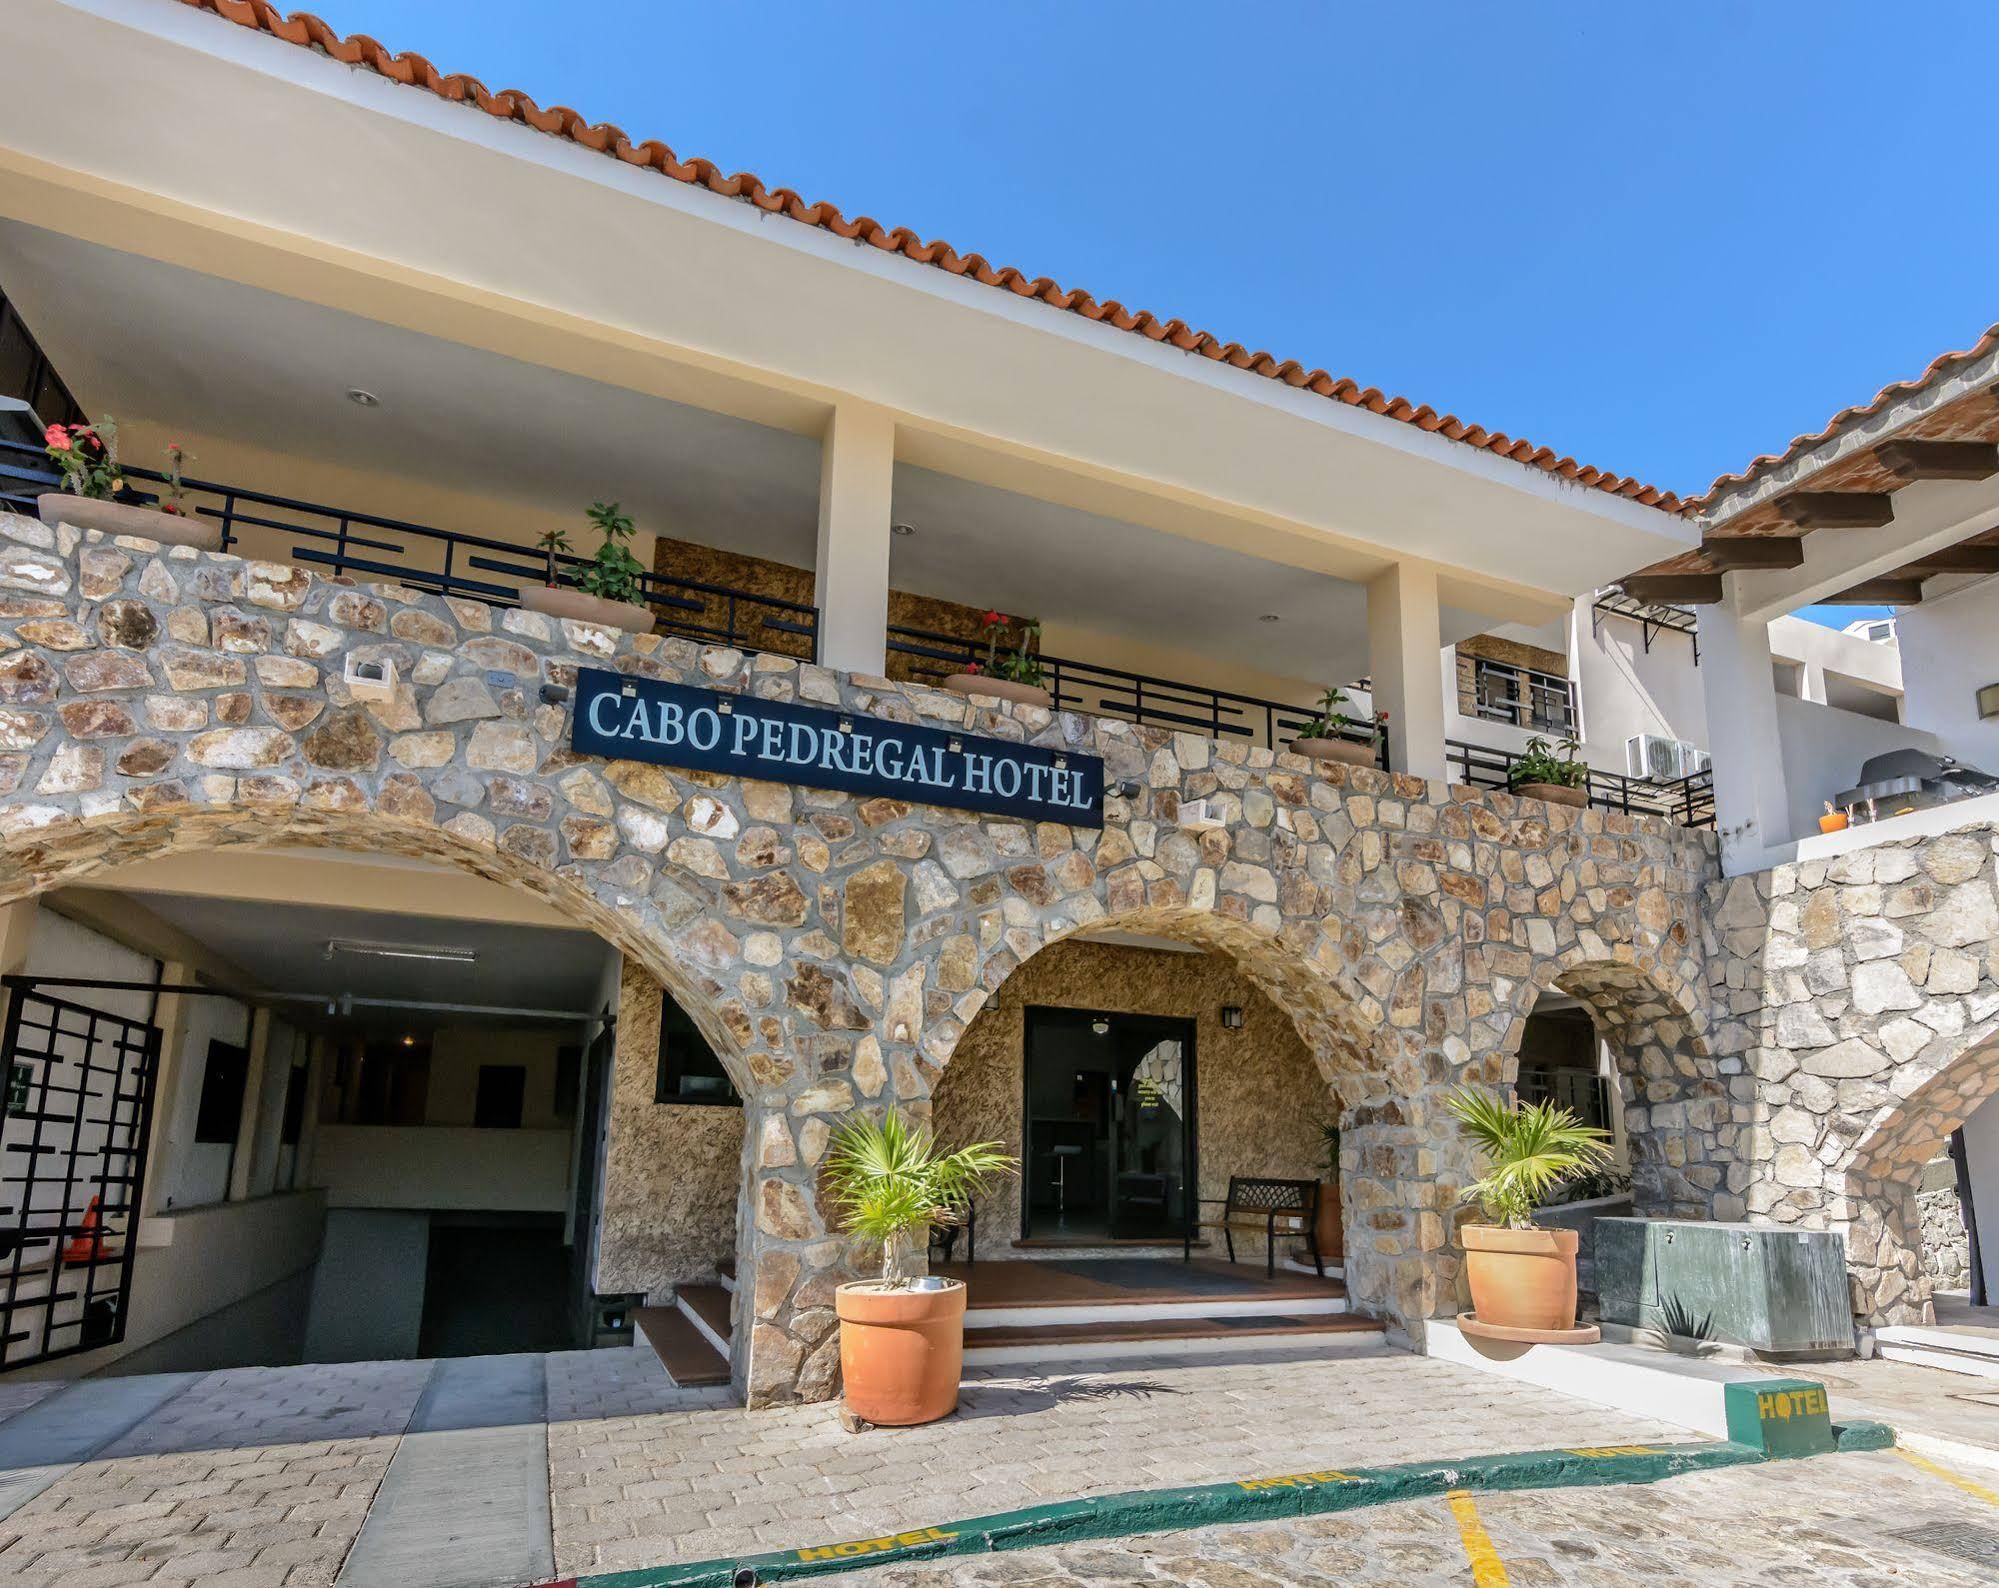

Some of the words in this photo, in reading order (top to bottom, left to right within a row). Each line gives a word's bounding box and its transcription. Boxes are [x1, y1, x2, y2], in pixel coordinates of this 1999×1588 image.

[588, 692, 722, 751] CABO
[730, 713, 956, 789] PEDREGAL
[961, 751, 1093, 810] HOTEL
[1758, 1389, 1829, 1420] HOTEL
[1236, 1470, 1361, 1491] HOTEL
[798, 1527, 960, 1562] HOTEL
